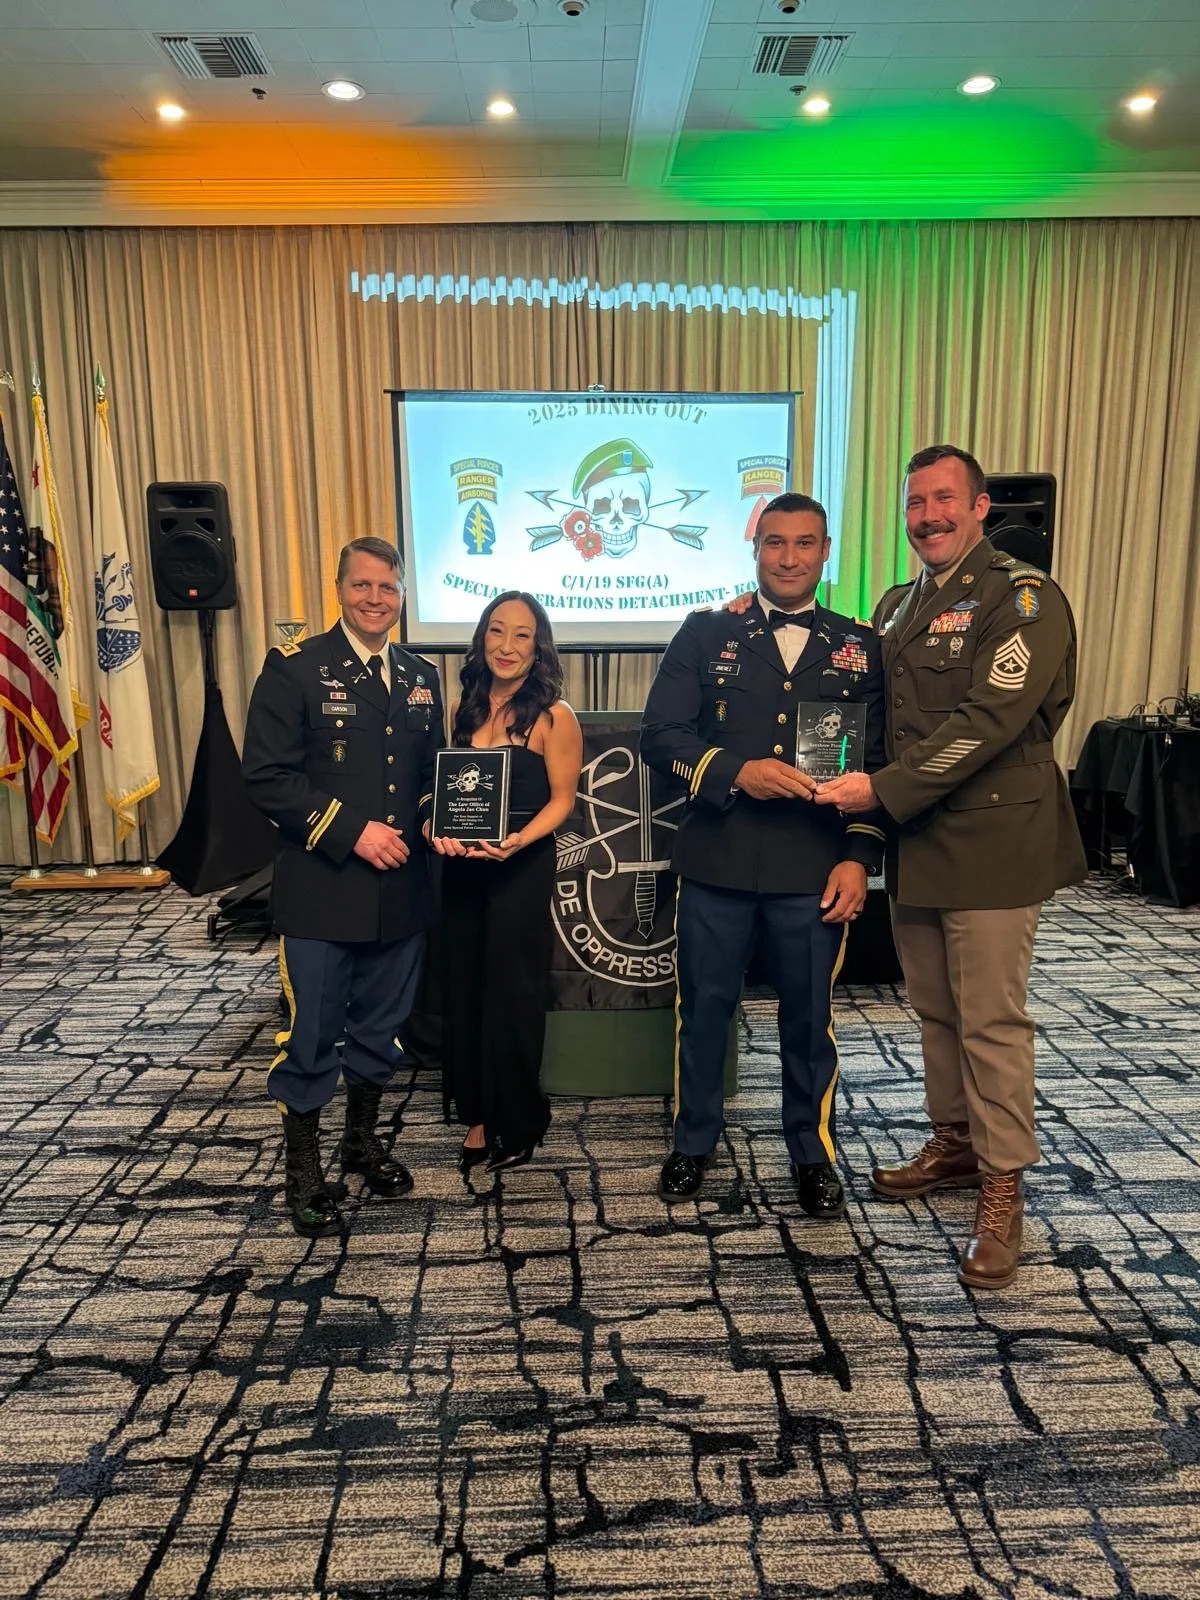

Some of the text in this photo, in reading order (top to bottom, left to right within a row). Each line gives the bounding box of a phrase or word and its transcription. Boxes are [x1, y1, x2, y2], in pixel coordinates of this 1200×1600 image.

[528, 397, 707, 426] 2025 DINING OUT
[460, 475, 494, 486] RANGER
[745, 470, 782, 482] RANGER
[461, 490, 494, 500] AIRBORNE
[562, 574, 669, 590] C/1/19 SFG(A)
[1014, 578, 1041, 587] AIRBORNE
[556, 880, 582, 916] DE
